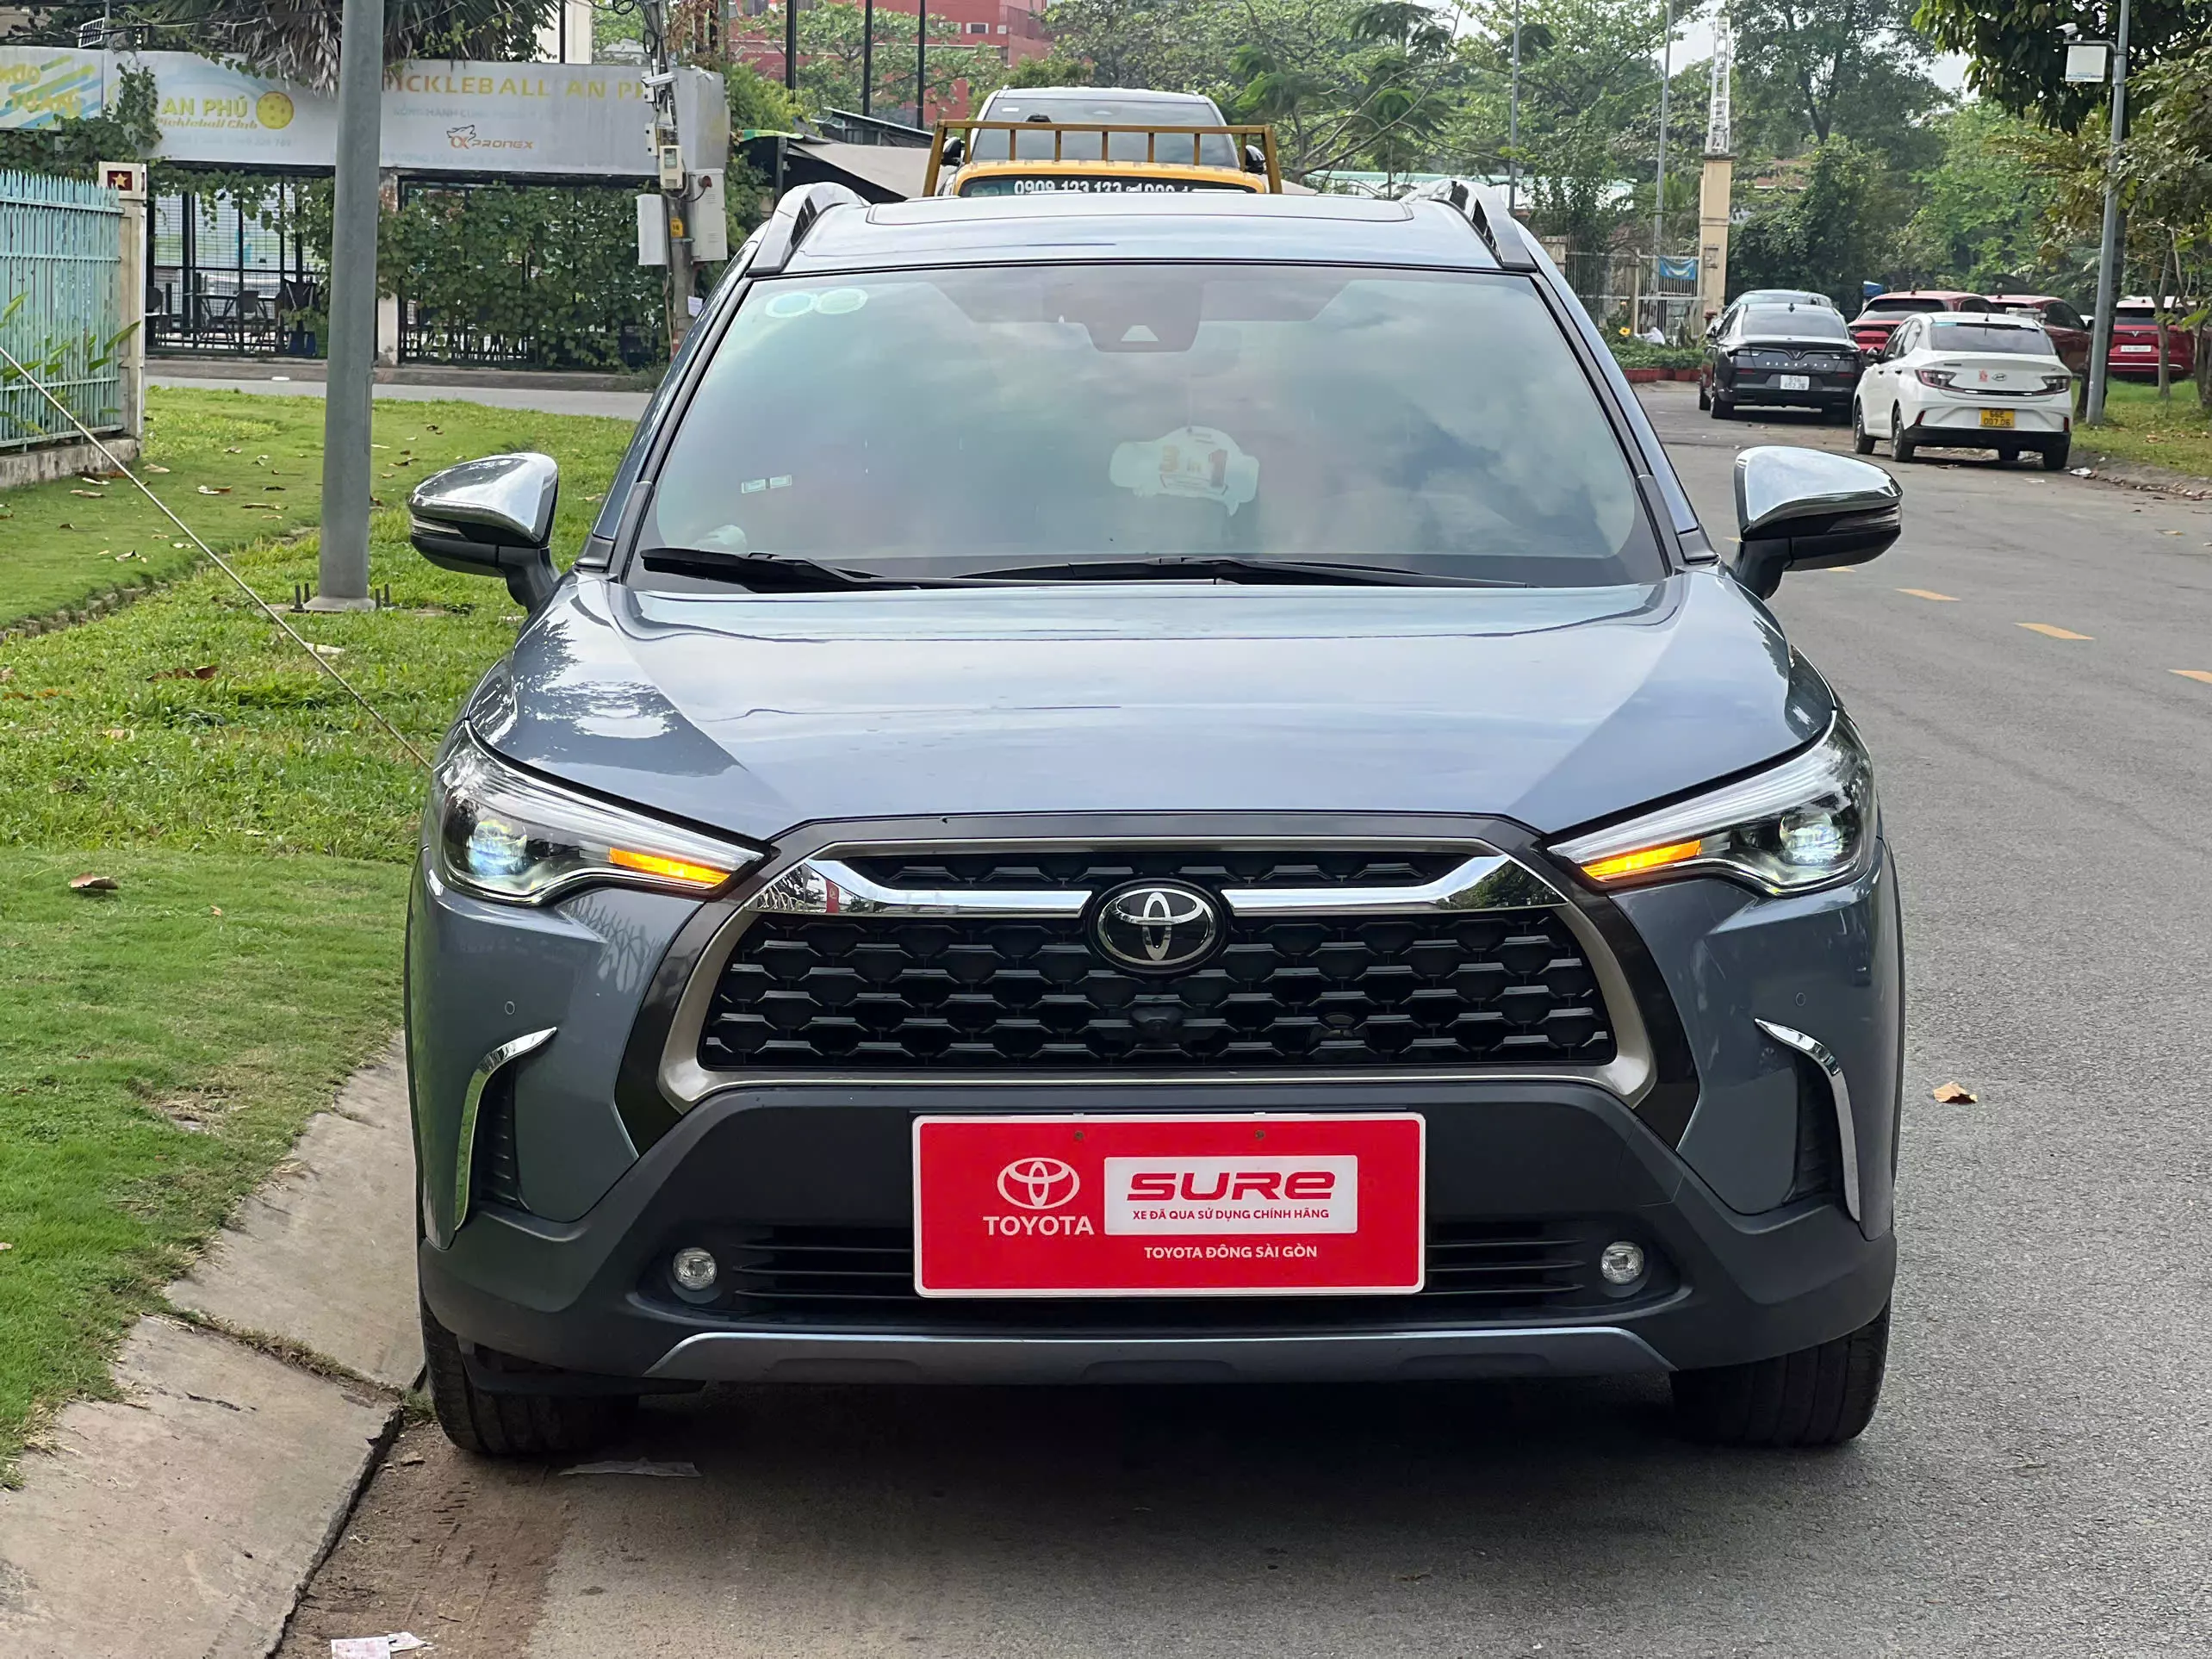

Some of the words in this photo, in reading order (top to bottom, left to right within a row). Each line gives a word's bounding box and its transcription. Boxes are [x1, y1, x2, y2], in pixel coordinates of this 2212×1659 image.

[383, 73, 550, 96] ICKLEBALL
[565, 81, 606, 99] AN
[161, 96, 195, 115] AN
[202, 95, 248, 118] PHÚ
[1133, 1210, 1147, 1220] XE
[1149, 1208, 1166, 1220] ĐÃ
[1169, 1210, 1195, 1221] QUA
[1197, 1207, 1214, 1220] SỬ
[1216, 1209, 1251, 1222] DỤNG
[1253, 1207, 1291, 1220] CHÍNH
[1295, 1207, 1329, 1219] HÃNG
[982, 1215, 1095, 1236] TOYOTA
[1144, 1246, 1203, 1258] TOYOTA
[1206, 1244, 1252, 1258] ĐÔNG
[1255, 1243, 1279, 1258] SÀI
[1283, 1243, 1318, 1258] GÒN
